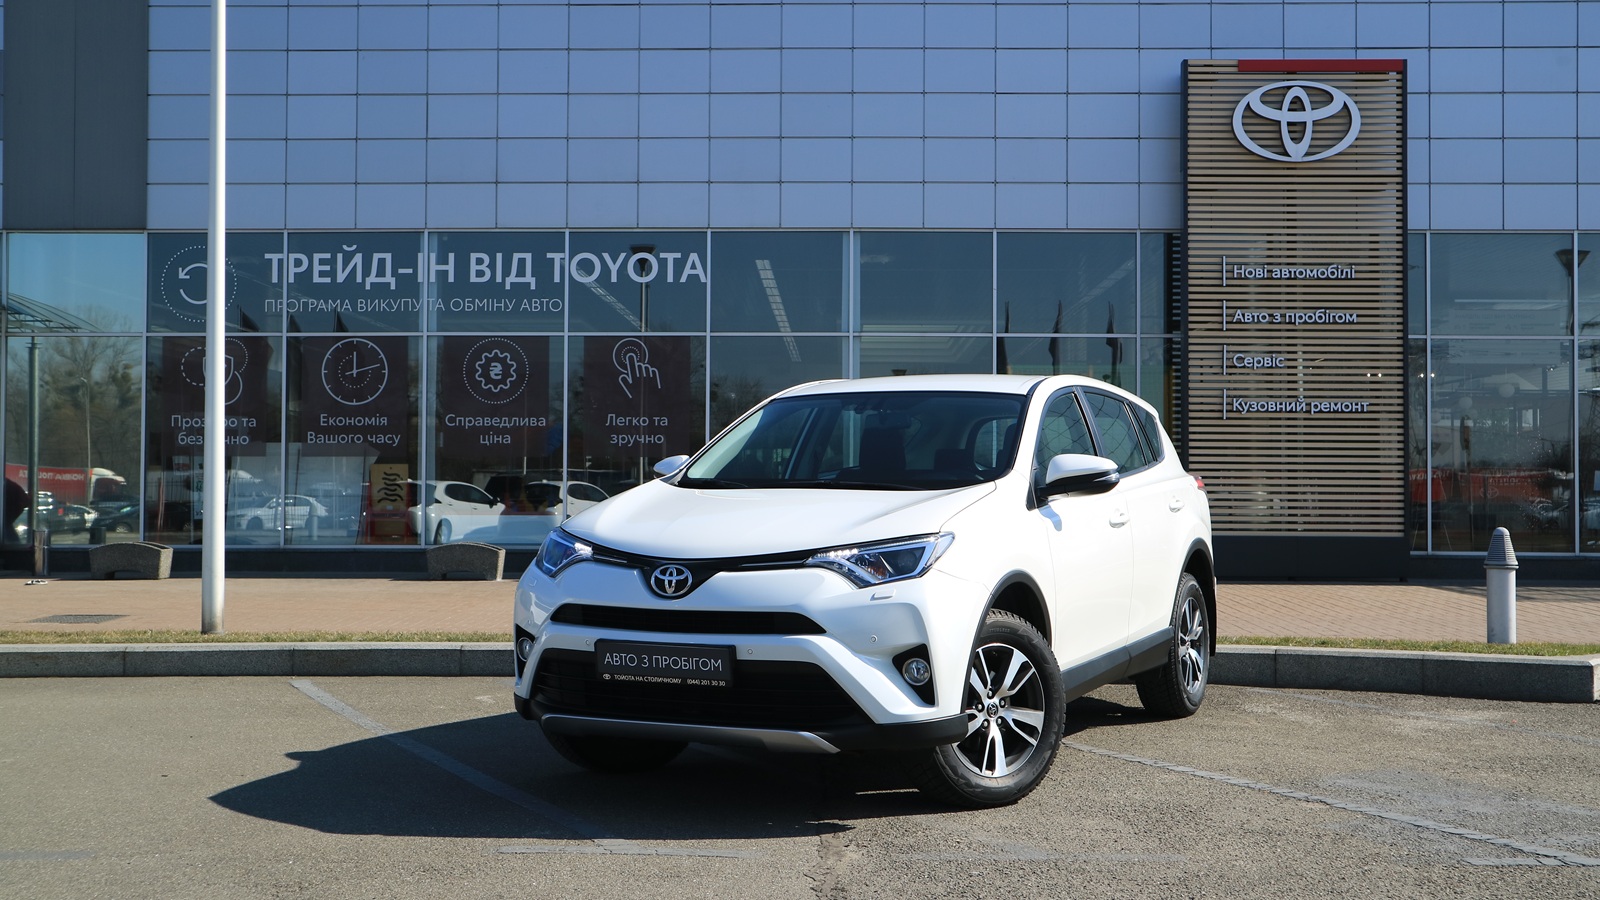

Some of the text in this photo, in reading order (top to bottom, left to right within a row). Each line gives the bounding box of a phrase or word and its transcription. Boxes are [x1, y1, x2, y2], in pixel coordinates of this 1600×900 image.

[264, 244, 707, 290] ТРЕЙД-ІН ВІД TOYOTA
[1233, 265, 1355, 279] Нові автомобілі
[264, 298, 563, 312] ПРОГРАМА ВИКУПУ ТА ОБМІНУ АВТО
[1233, 309, 1357, 325] Авто з пробігом
[1233, 354, 1285, 370] Сервіс
[1233, 394, 1369, 415] Кузовний ремонт
[241, 418, 257, 427] та
[320, 414, 388, 426] Економія
[445, 414, 546, 429] Справедлива
[606, 414, 668, 427] Легко та
[307, 432, 401, 447] Вашого часу
[480, 433, 511, 446] ціна
[610, 434, 665, 447] зручно
[604, 653, 638, 667] АВТО
[652, 655, 722, 671] ПРОБІГОМ
[644, 676, 682, 684] СТОЛИЧНОМУ
